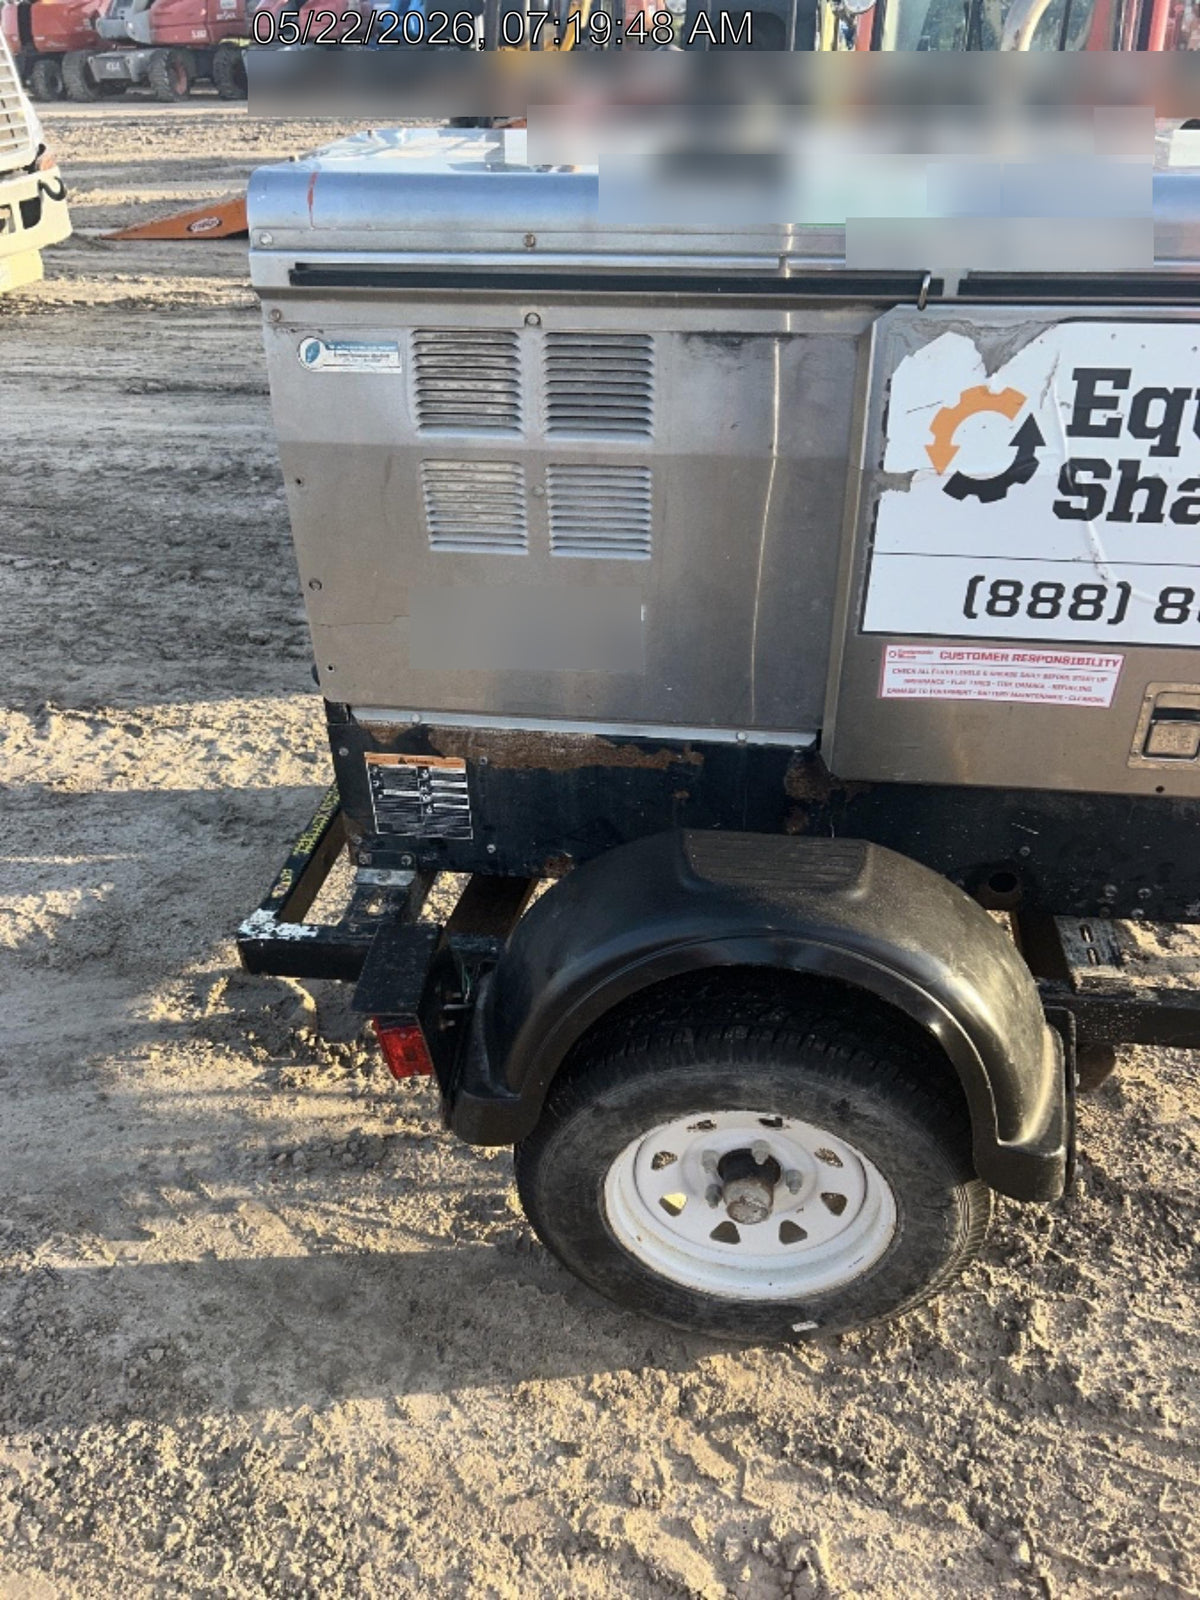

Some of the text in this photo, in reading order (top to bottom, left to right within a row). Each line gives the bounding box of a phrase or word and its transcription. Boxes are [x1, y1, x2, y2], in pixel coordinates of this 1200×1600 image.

[1066, 367, 1200, 457] Eq
[963, 575, 1200, 625] (888) 8
[939, 651, 1009, 661] CUSTOMER
[1012, 653, 1120, 667] RESPONSIBILITY
